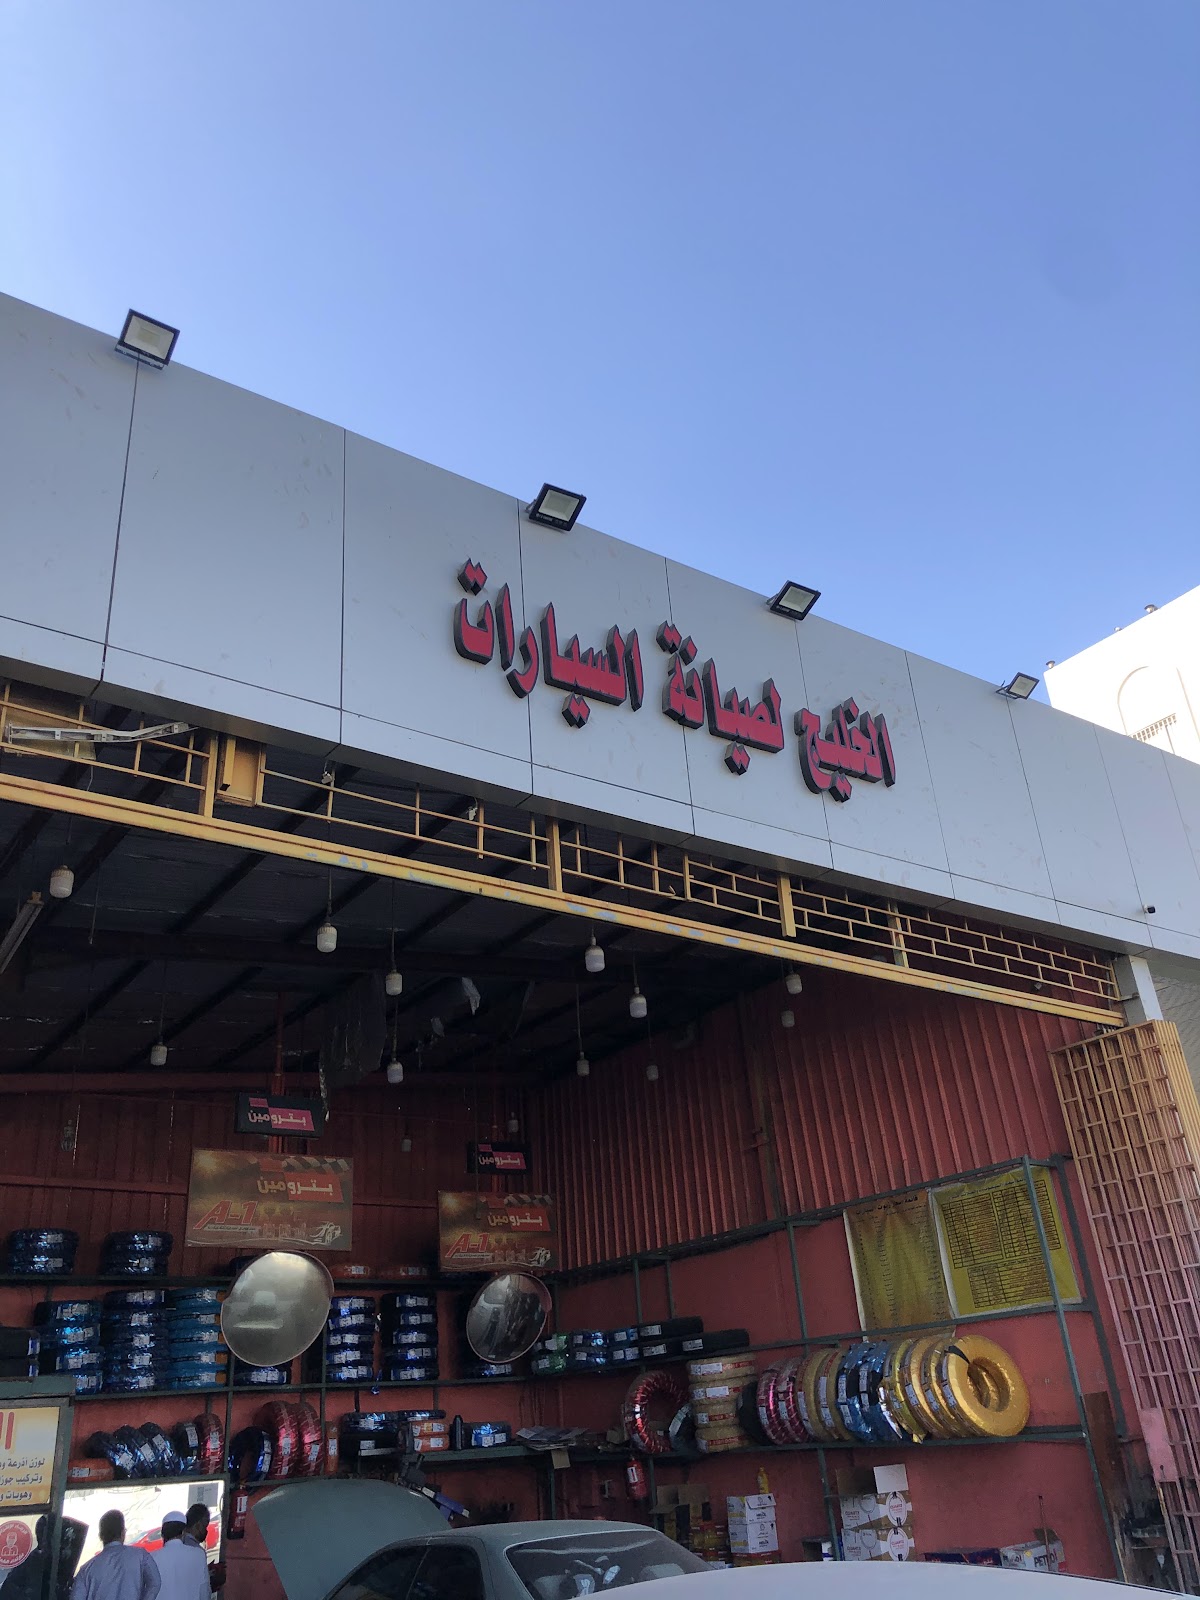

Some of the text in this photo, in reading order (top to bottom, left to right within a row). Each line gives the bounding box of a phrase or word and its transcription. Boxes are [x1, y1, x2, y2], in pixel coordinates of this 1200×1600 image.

[453, 558, 896, 802] الخليج لصيانة السيارات
[248, 1110, 307, 1126] بترومين
[257, 1176, 334, 1195] بترومين
[193, 1200, 259, 1230] A-1
[444, 1232, 490, 1258] A-1
[16, 1473, 43, 1485] وتركيب
